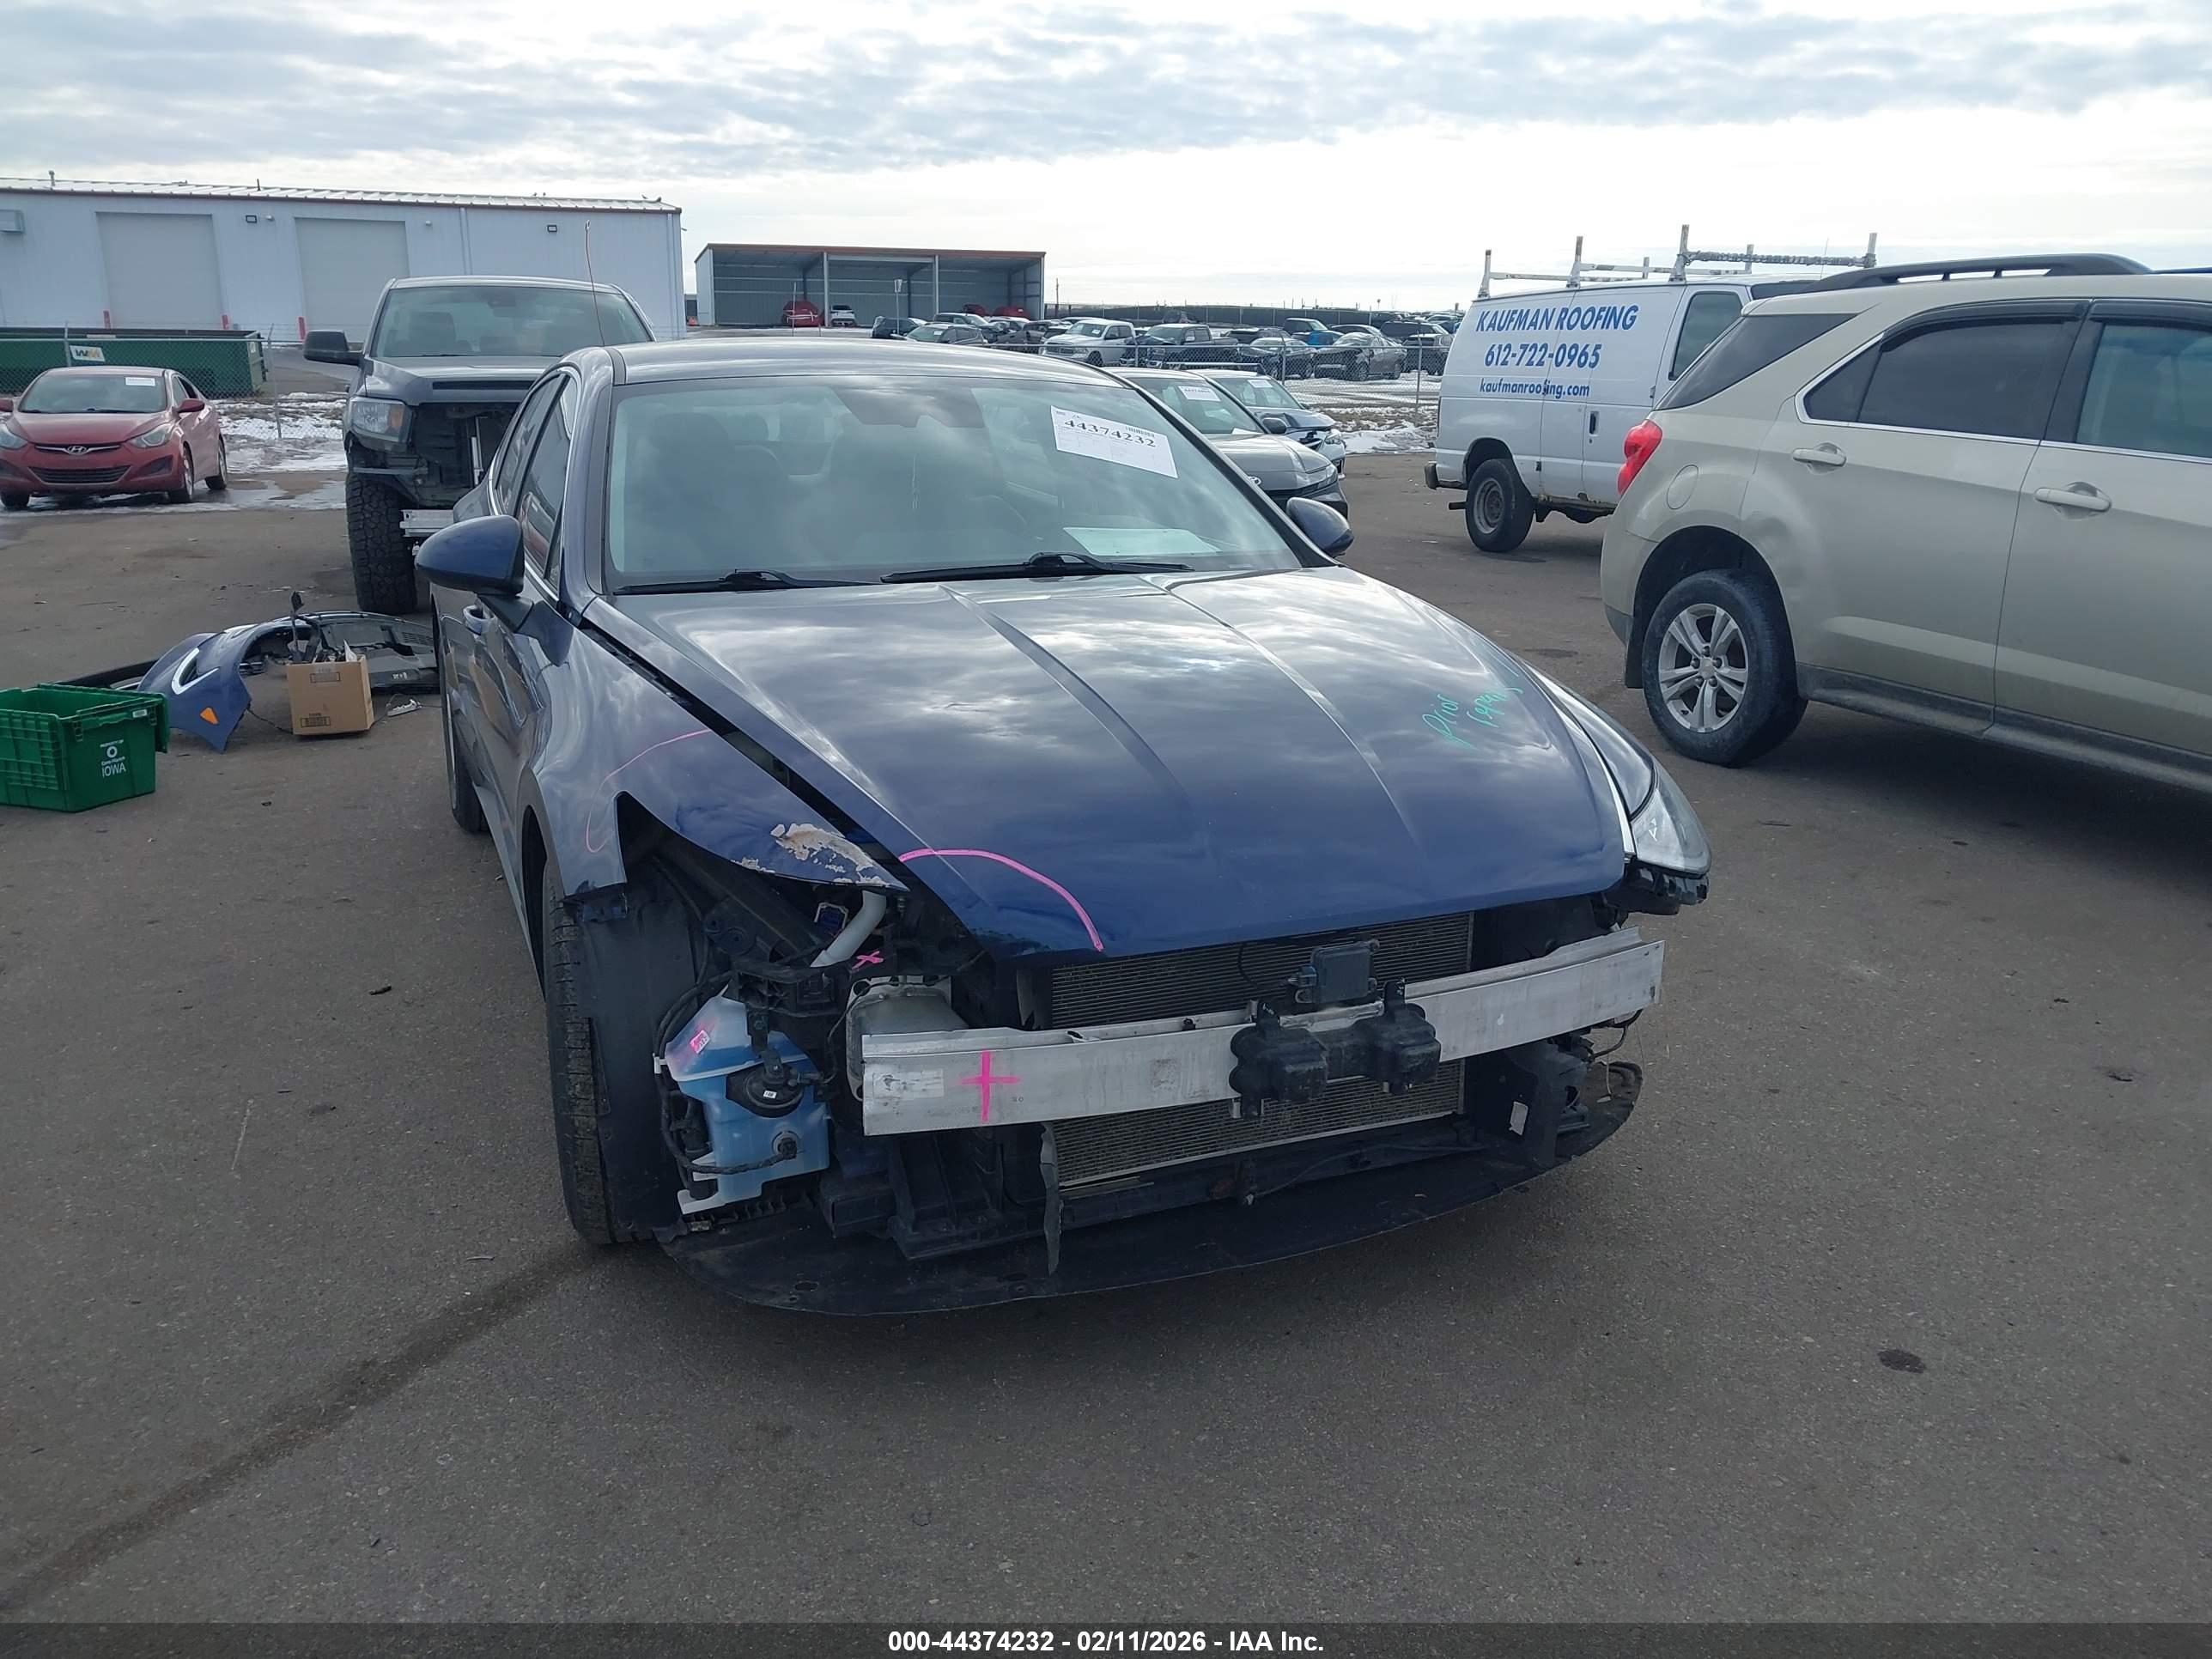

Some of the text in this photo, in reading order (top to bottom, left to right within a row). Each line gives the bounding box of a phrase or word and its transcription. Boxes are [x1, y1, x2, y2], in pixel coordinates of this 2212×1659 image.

[1476, 305, 1639, 331] KAUFMAN ROOFING
[75, 349, 100, 358] WM
[1485, 343, 1602, 369] 612-722-0965
[1480, 378, 1590, 399] kaufmanroofing.com
[1064, 419, 1156, 447] 44374232
[101, 763, 126, 778] IOWA
